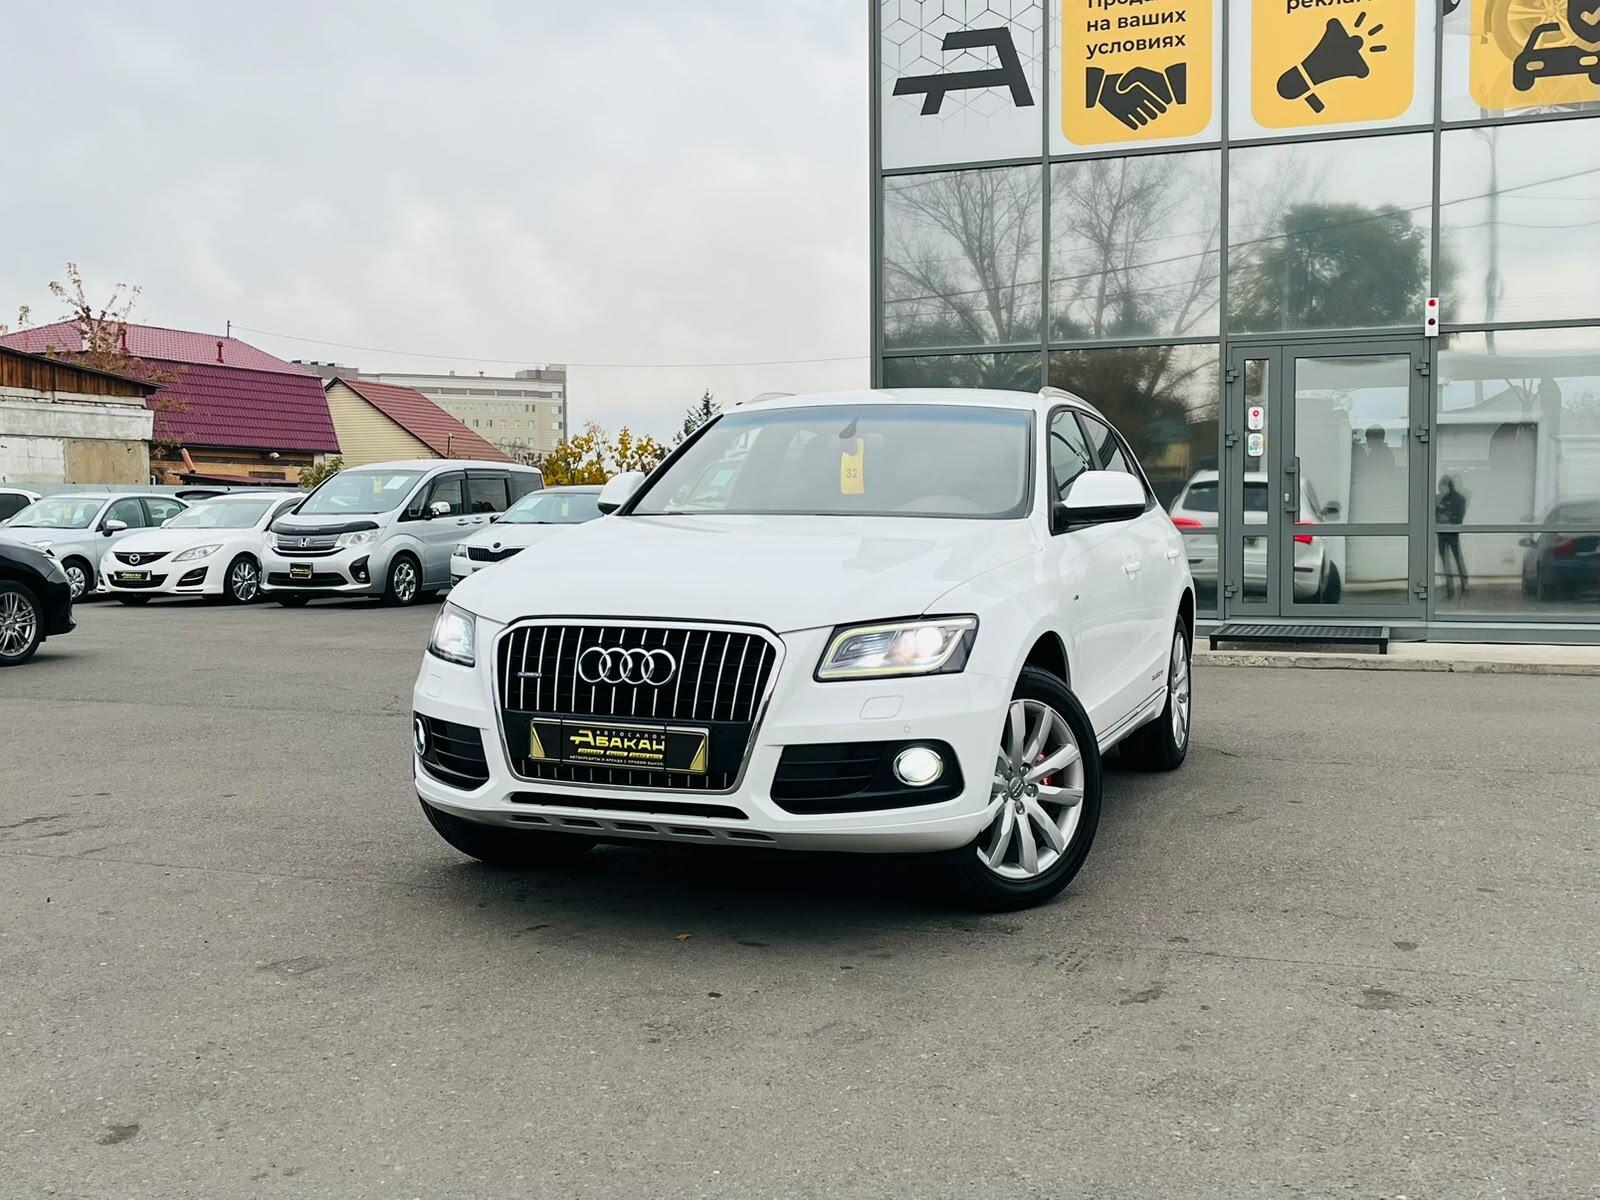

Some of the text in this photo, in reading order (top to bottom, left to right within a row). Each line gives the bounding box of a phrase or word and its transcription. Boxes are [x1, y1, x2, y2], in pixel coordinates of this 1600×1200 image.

[1087, 10, 1186, 32] на ваших
[1086, 34, 1186, 60] условиях
[846, 468, 857, 479] 32
